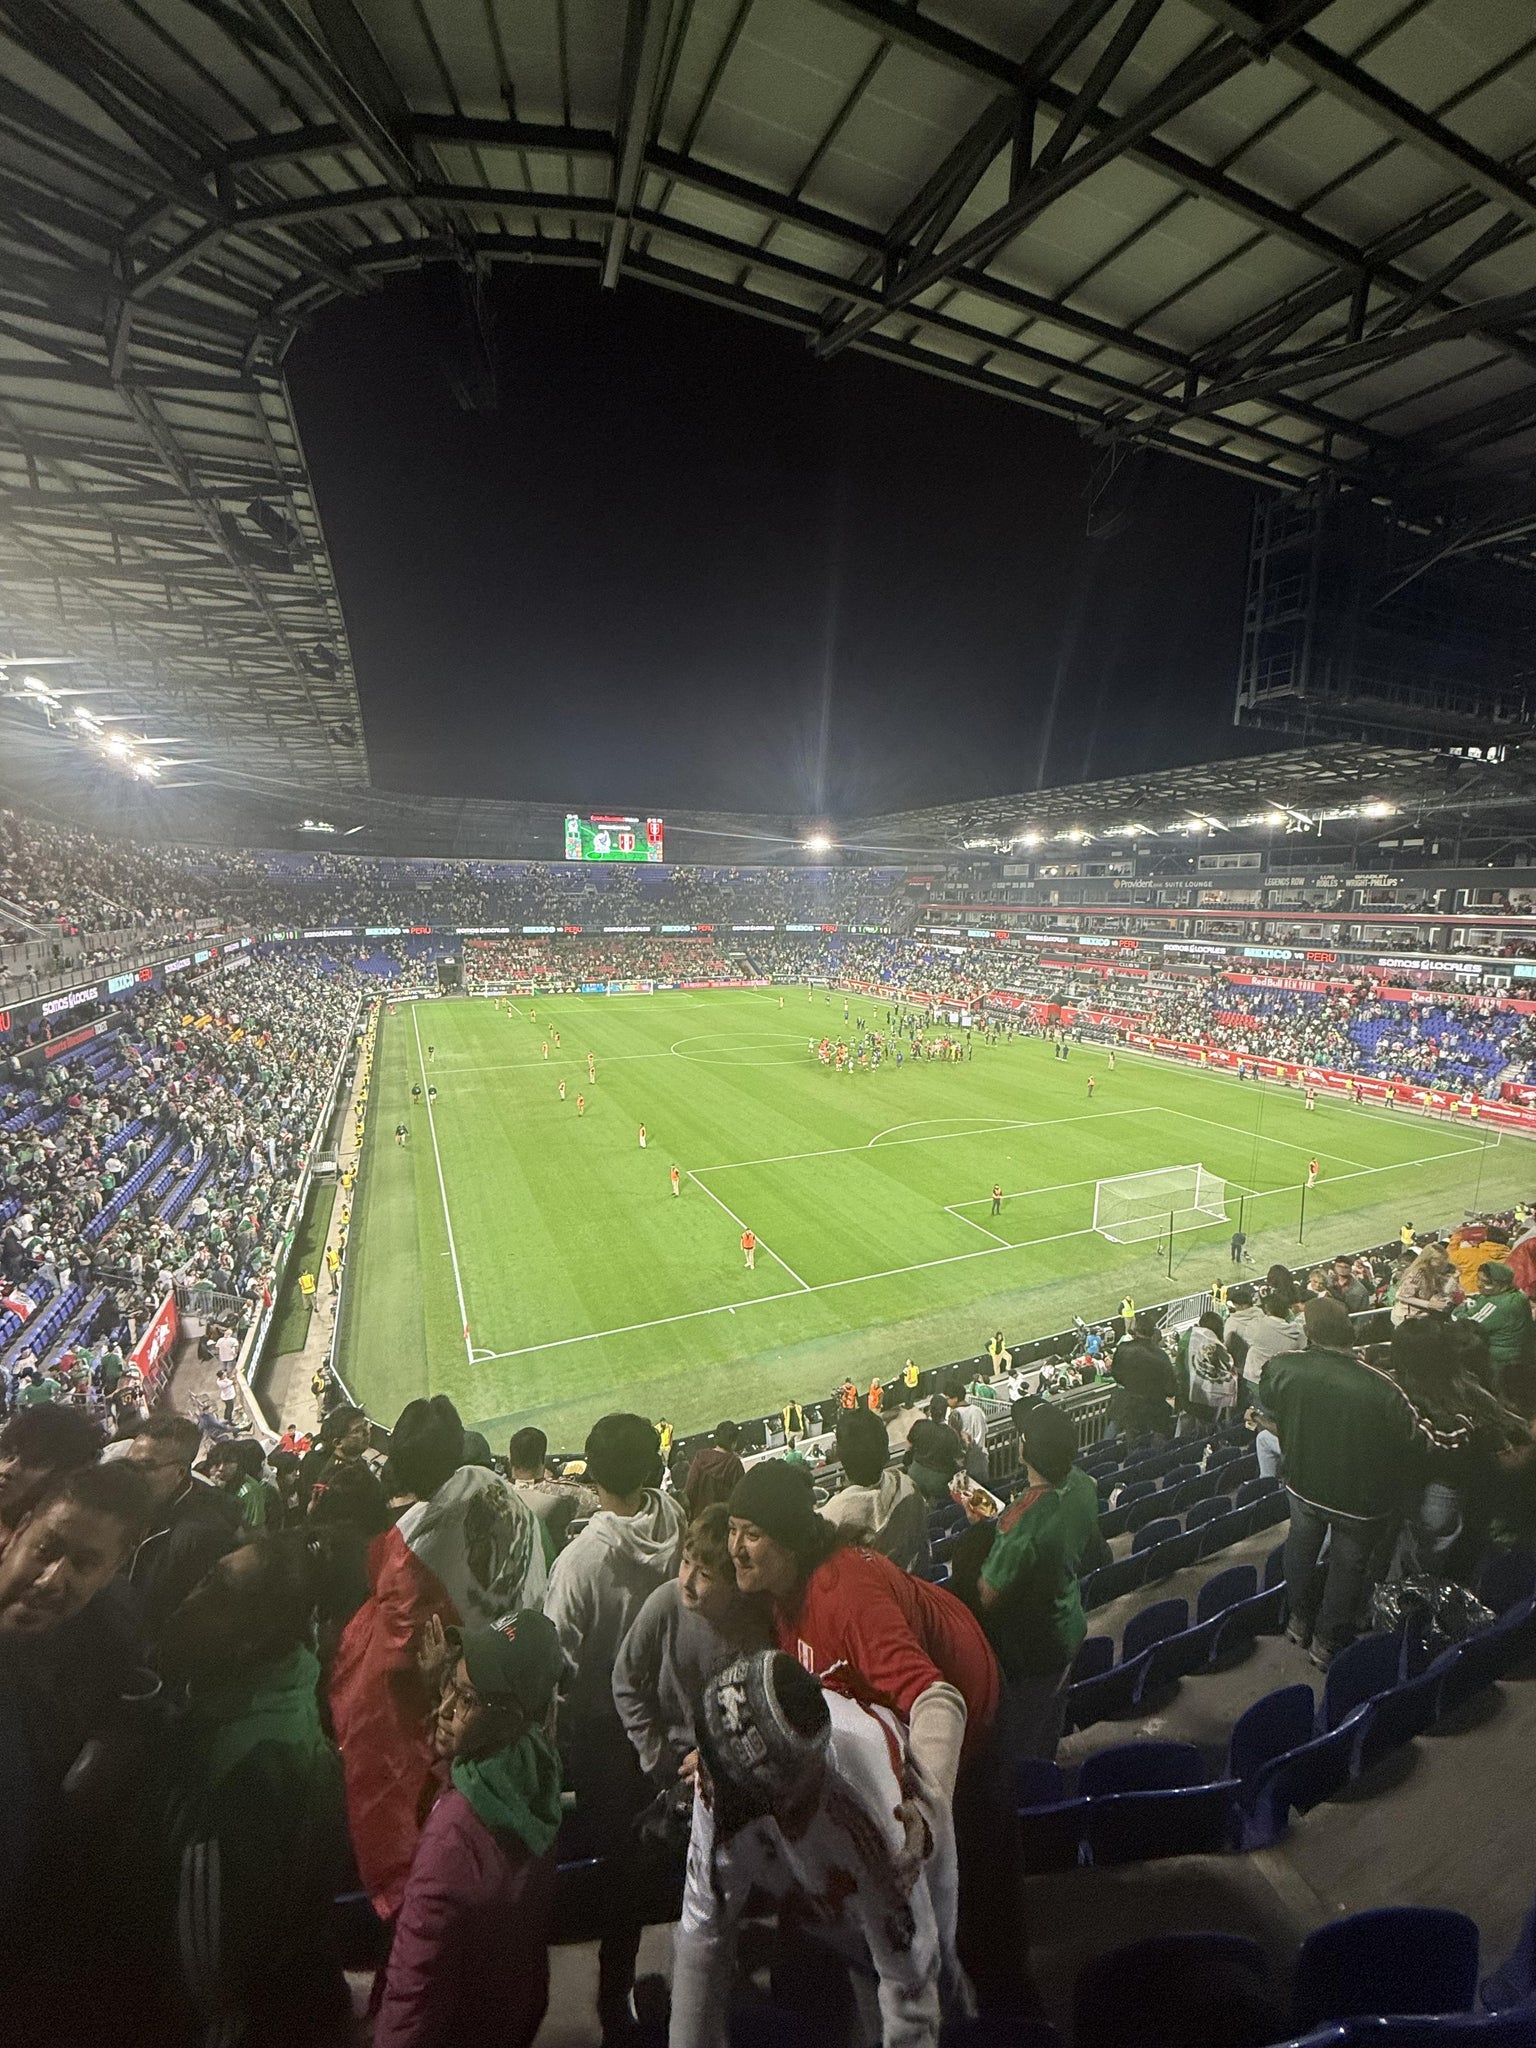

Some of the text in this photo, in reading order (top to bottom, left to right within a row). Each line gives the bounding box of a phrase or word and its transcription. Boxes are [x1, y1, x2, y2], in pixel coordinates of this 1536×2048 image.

[1120, 879, 1153, 888] Provident
[1264, 877, 1306, 887] LEGENDS ROW
[1119, 939, 1139, 949] PERU
[1306, 951, 1338, 963] PERU
[1378, 958, 1482, 973] SOMOS LOCALES
[1251, 976, 1267, 985] Red
[1267, 978, 1283, 988] Bull
[1411, 992, 1433, 1003] Red
